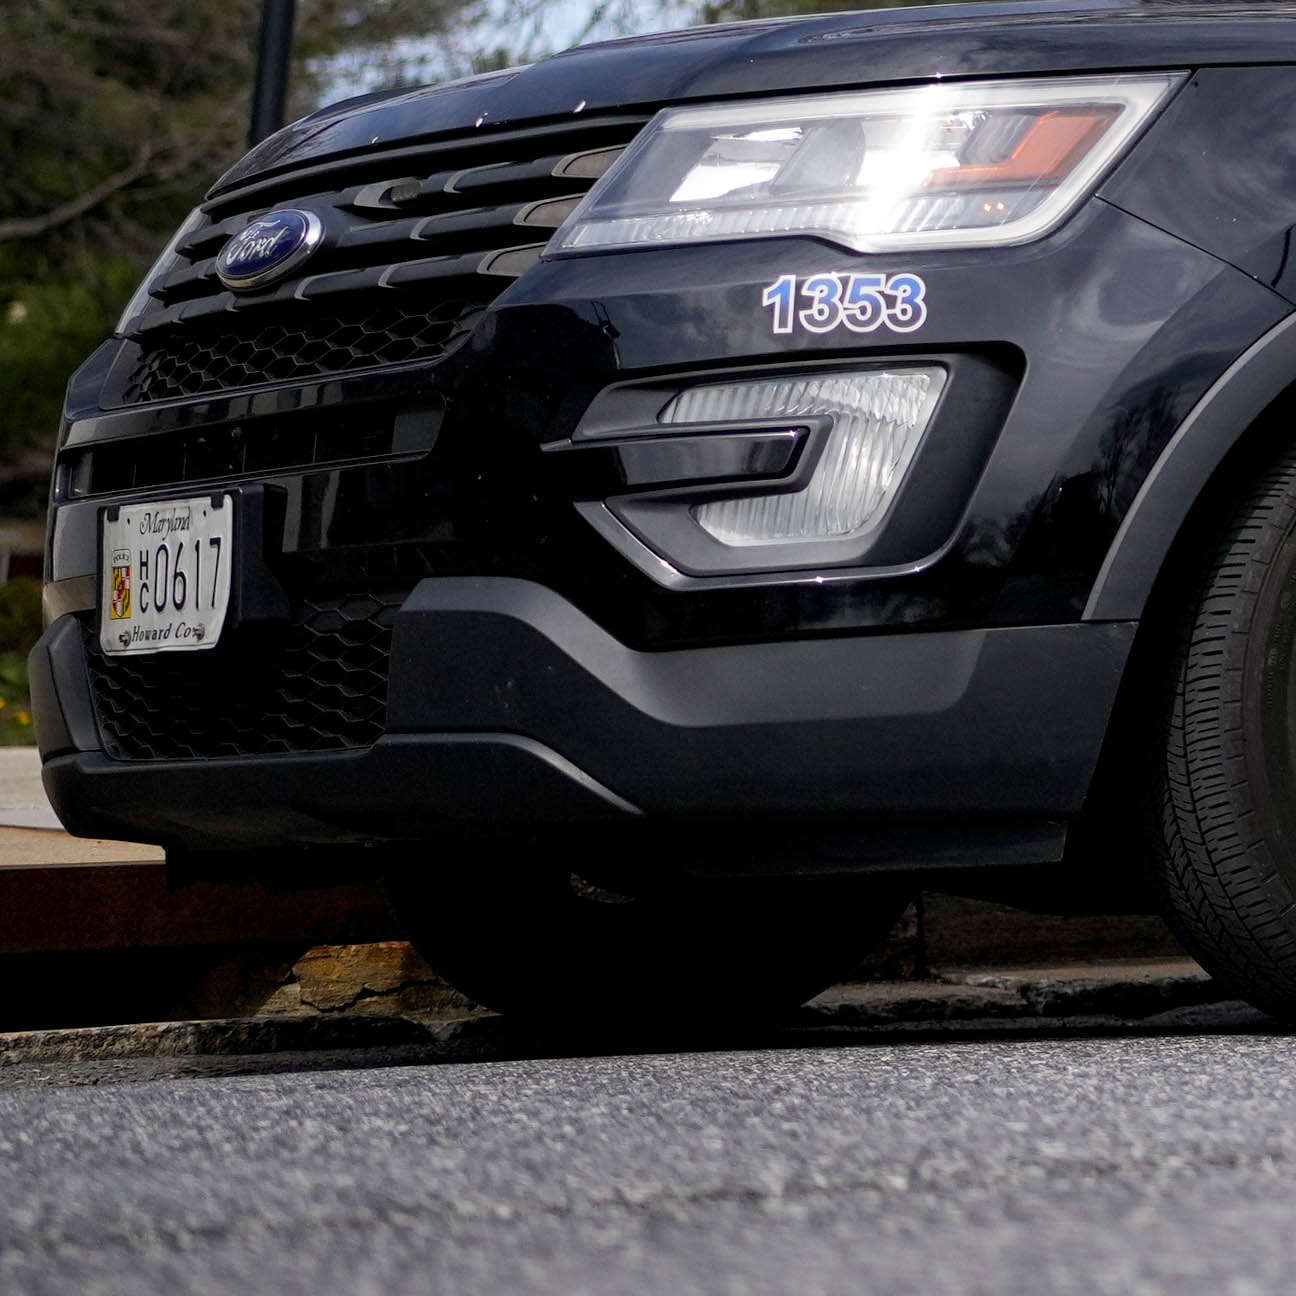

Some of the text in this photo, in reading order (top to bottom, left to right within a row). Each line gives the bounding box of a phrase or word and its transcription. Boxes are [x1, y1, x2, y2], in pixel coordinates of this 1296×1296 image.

[226, 219, 289, 266] Ford
[762, 272, 928, 335] 1353
[139, 506, 191, 541] Maryland
[154, 536, 222, 613] 0617
[131, 623, 171, 642] Howard
